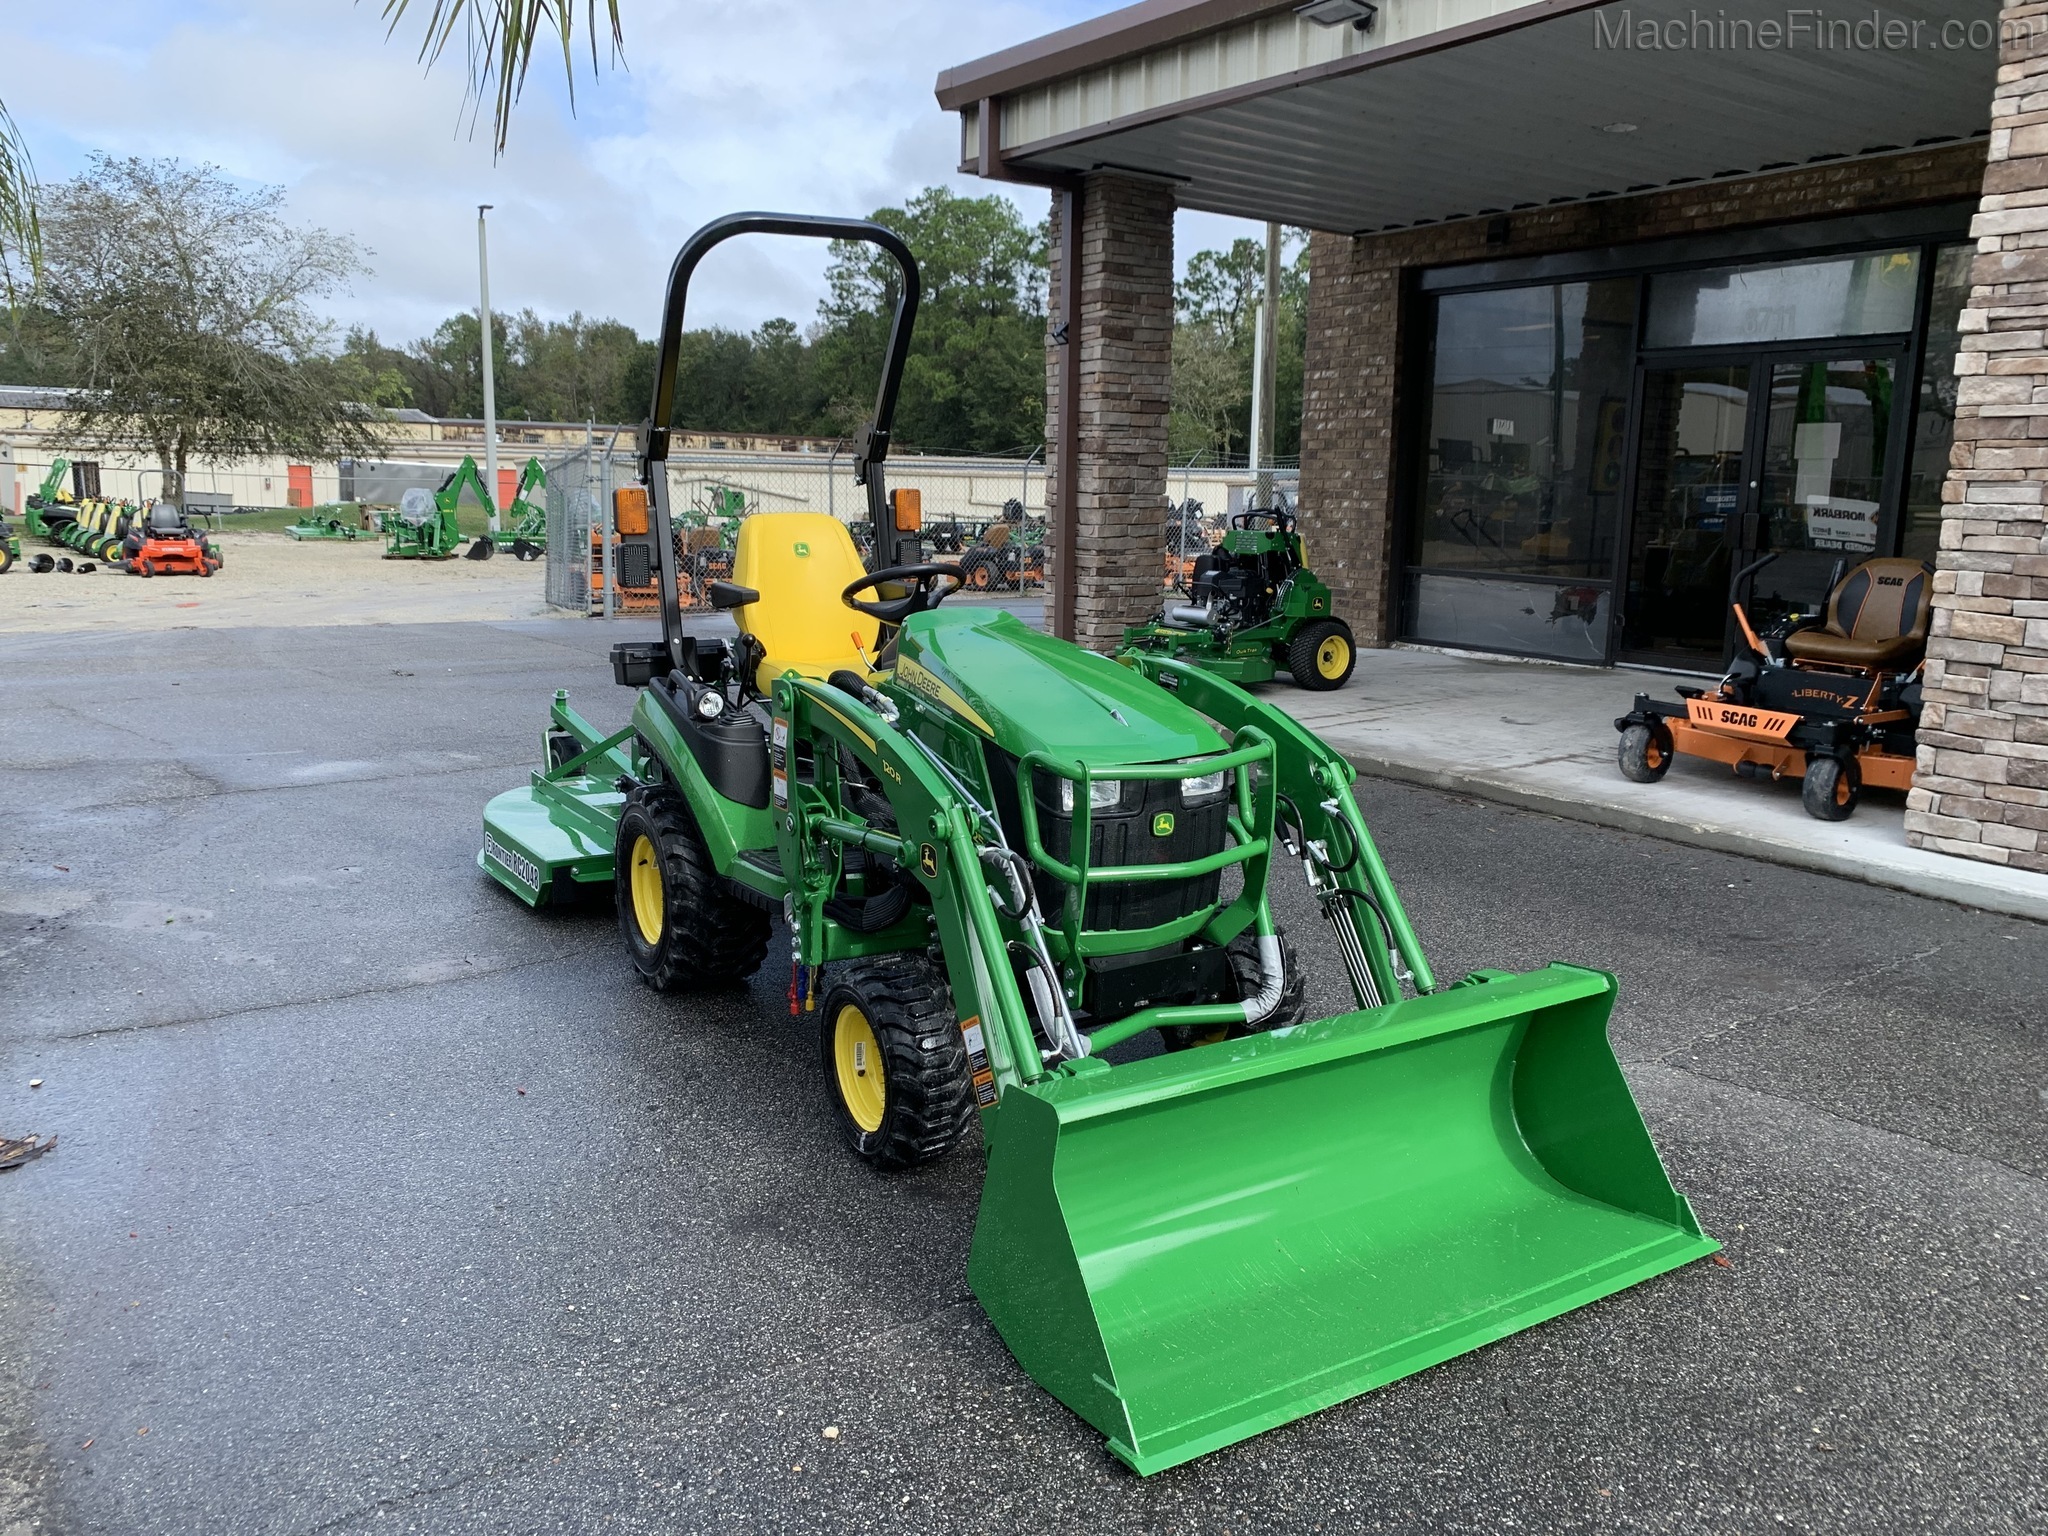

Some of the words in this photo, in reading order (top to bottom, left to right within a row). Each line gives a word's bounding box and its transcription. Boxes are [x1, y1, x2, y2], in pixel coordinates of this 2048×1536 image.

[1877, 576, 1904, 587] SCAG
[899, 662, 918, 685] JOHN
[917, 671, 941, 699] DEERE
[1793, 688, 1843, 704] LIBERTY
[1842, 695, 1859, 709] Z
[1720, 709, 1758, 728] SCAG
[512, 850, 539, 892] RC2048
